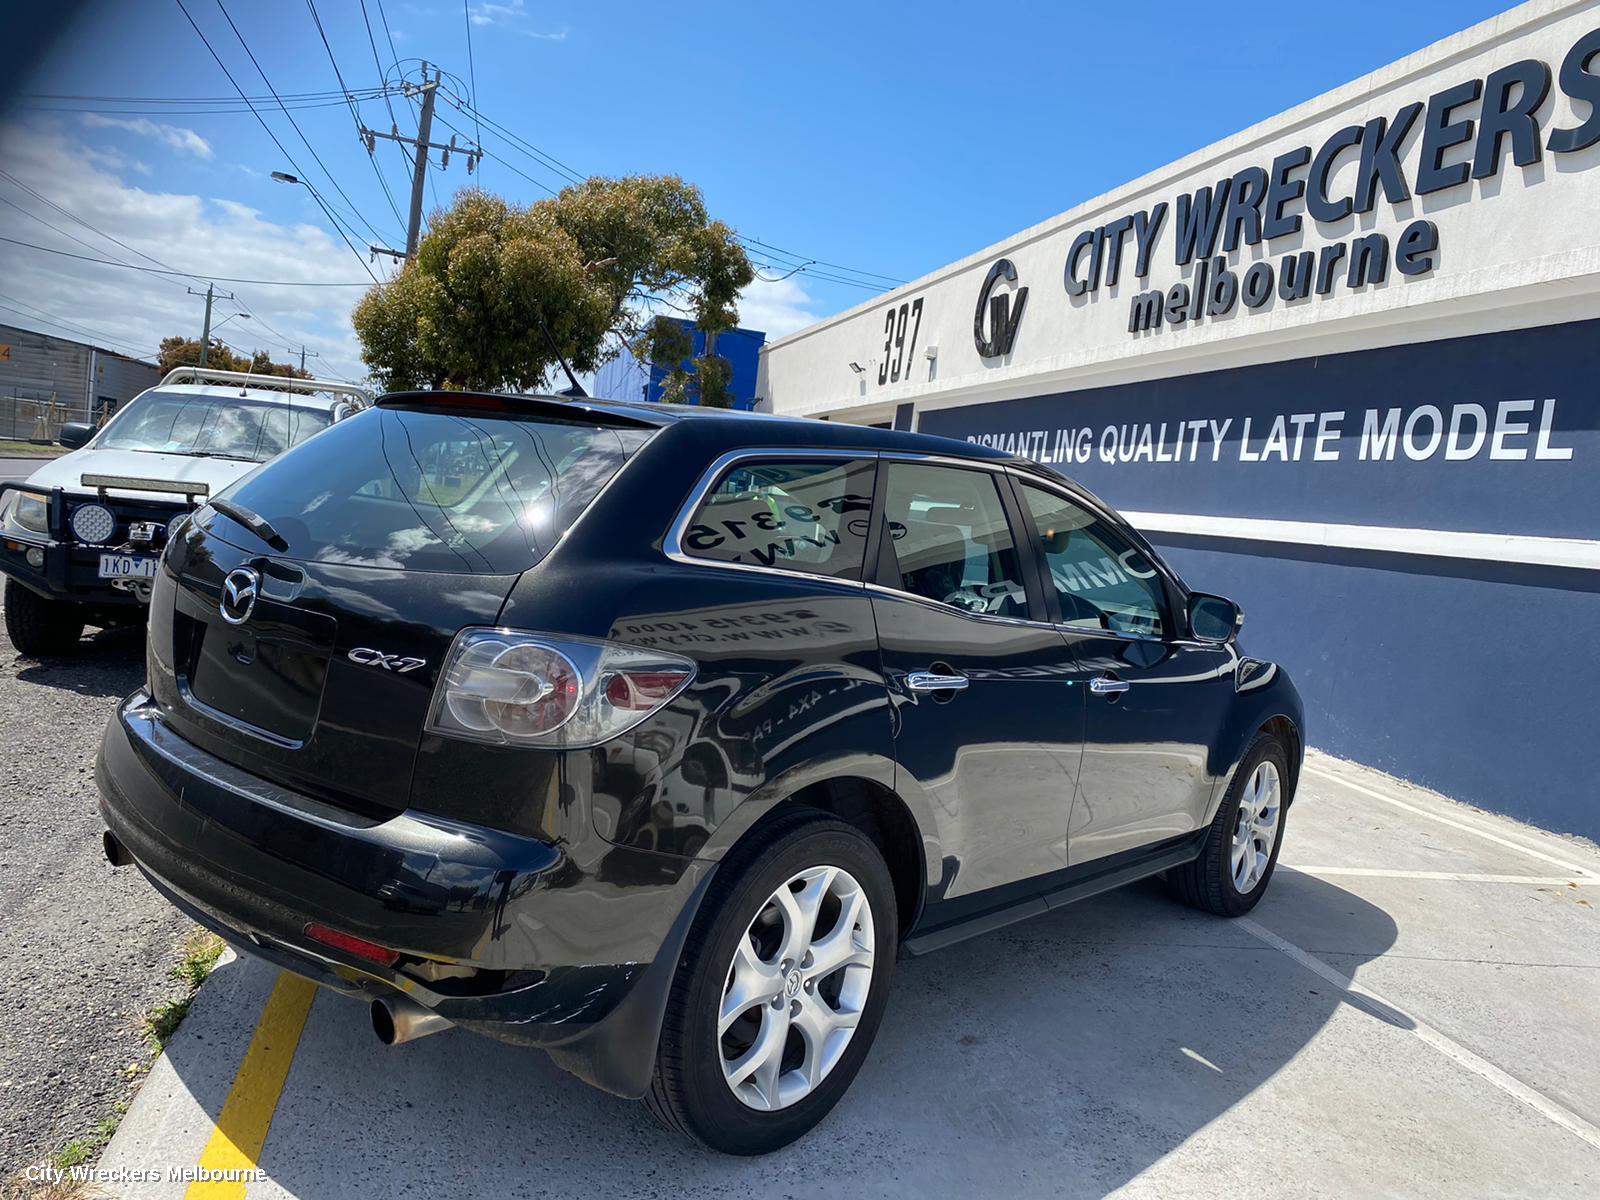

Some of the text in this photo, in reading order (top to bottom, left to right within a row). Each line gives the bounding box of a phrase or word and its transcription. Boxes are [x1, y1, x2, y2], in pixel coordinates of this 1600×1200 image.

[1063, 27, 1600, 298] CITY WRECKERS
[1128, 220, 1438, 333] melbourne
[878, 297, 925, 386] 397
[1099, 418, 1233, 466] QUALITY
[1239, 411, 1345, 462] LATE
[1358, 399, 1574, 462] MODEL
[347, 647, 427, 673] CX-7
